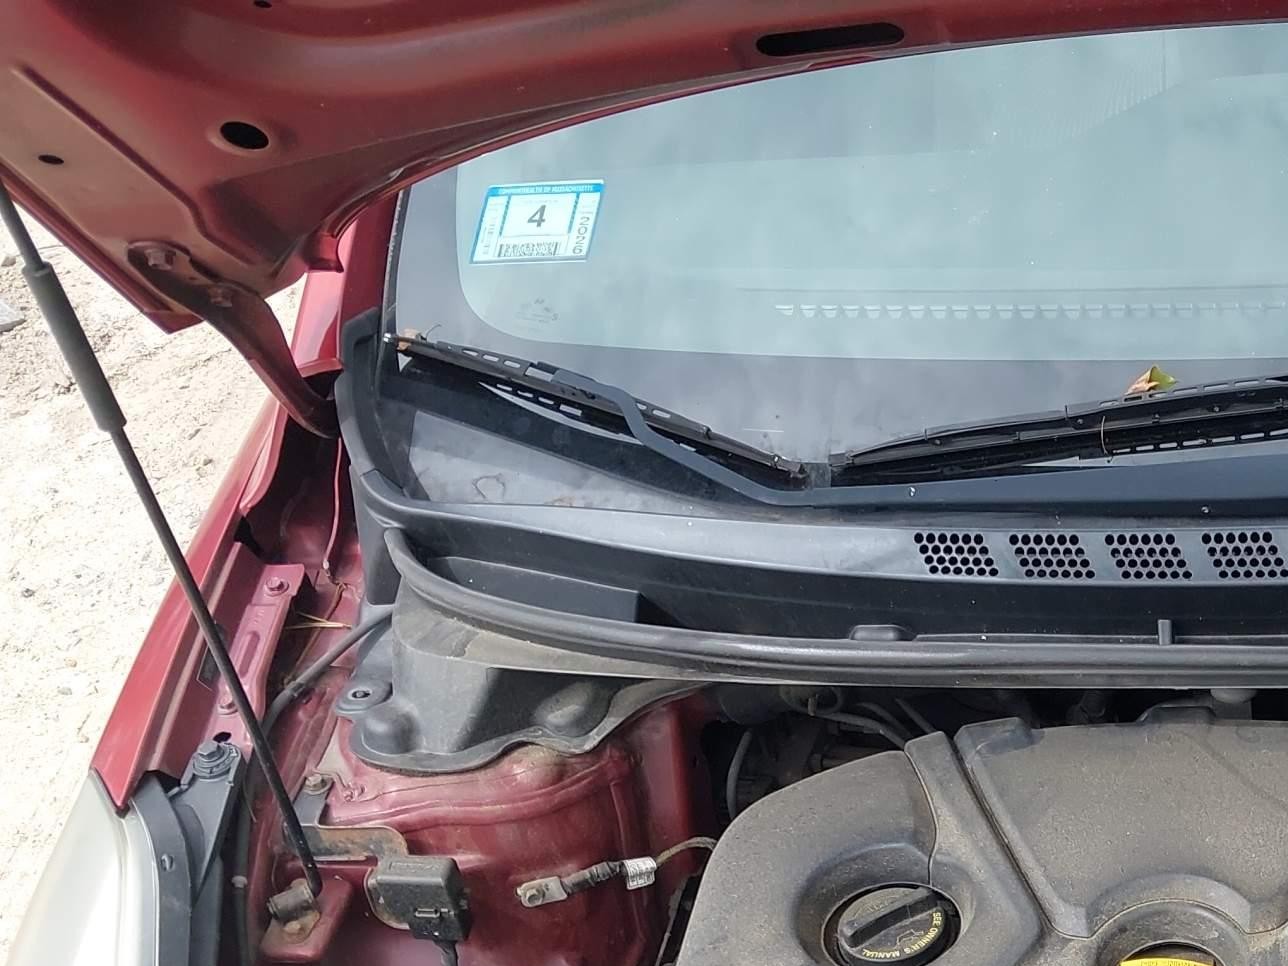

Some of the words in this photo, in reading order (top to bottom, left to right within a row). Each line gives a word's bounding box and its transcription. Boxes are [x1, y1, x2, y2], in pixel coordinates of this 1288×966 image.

[527, 204, 546, 228] 4
[572, 216, 590, 255] 2026
[932, 912, 942, 927] SEE
[903, 927, 938, 954] OWNER'S
[862, 948, 900, 959] MANUAL
